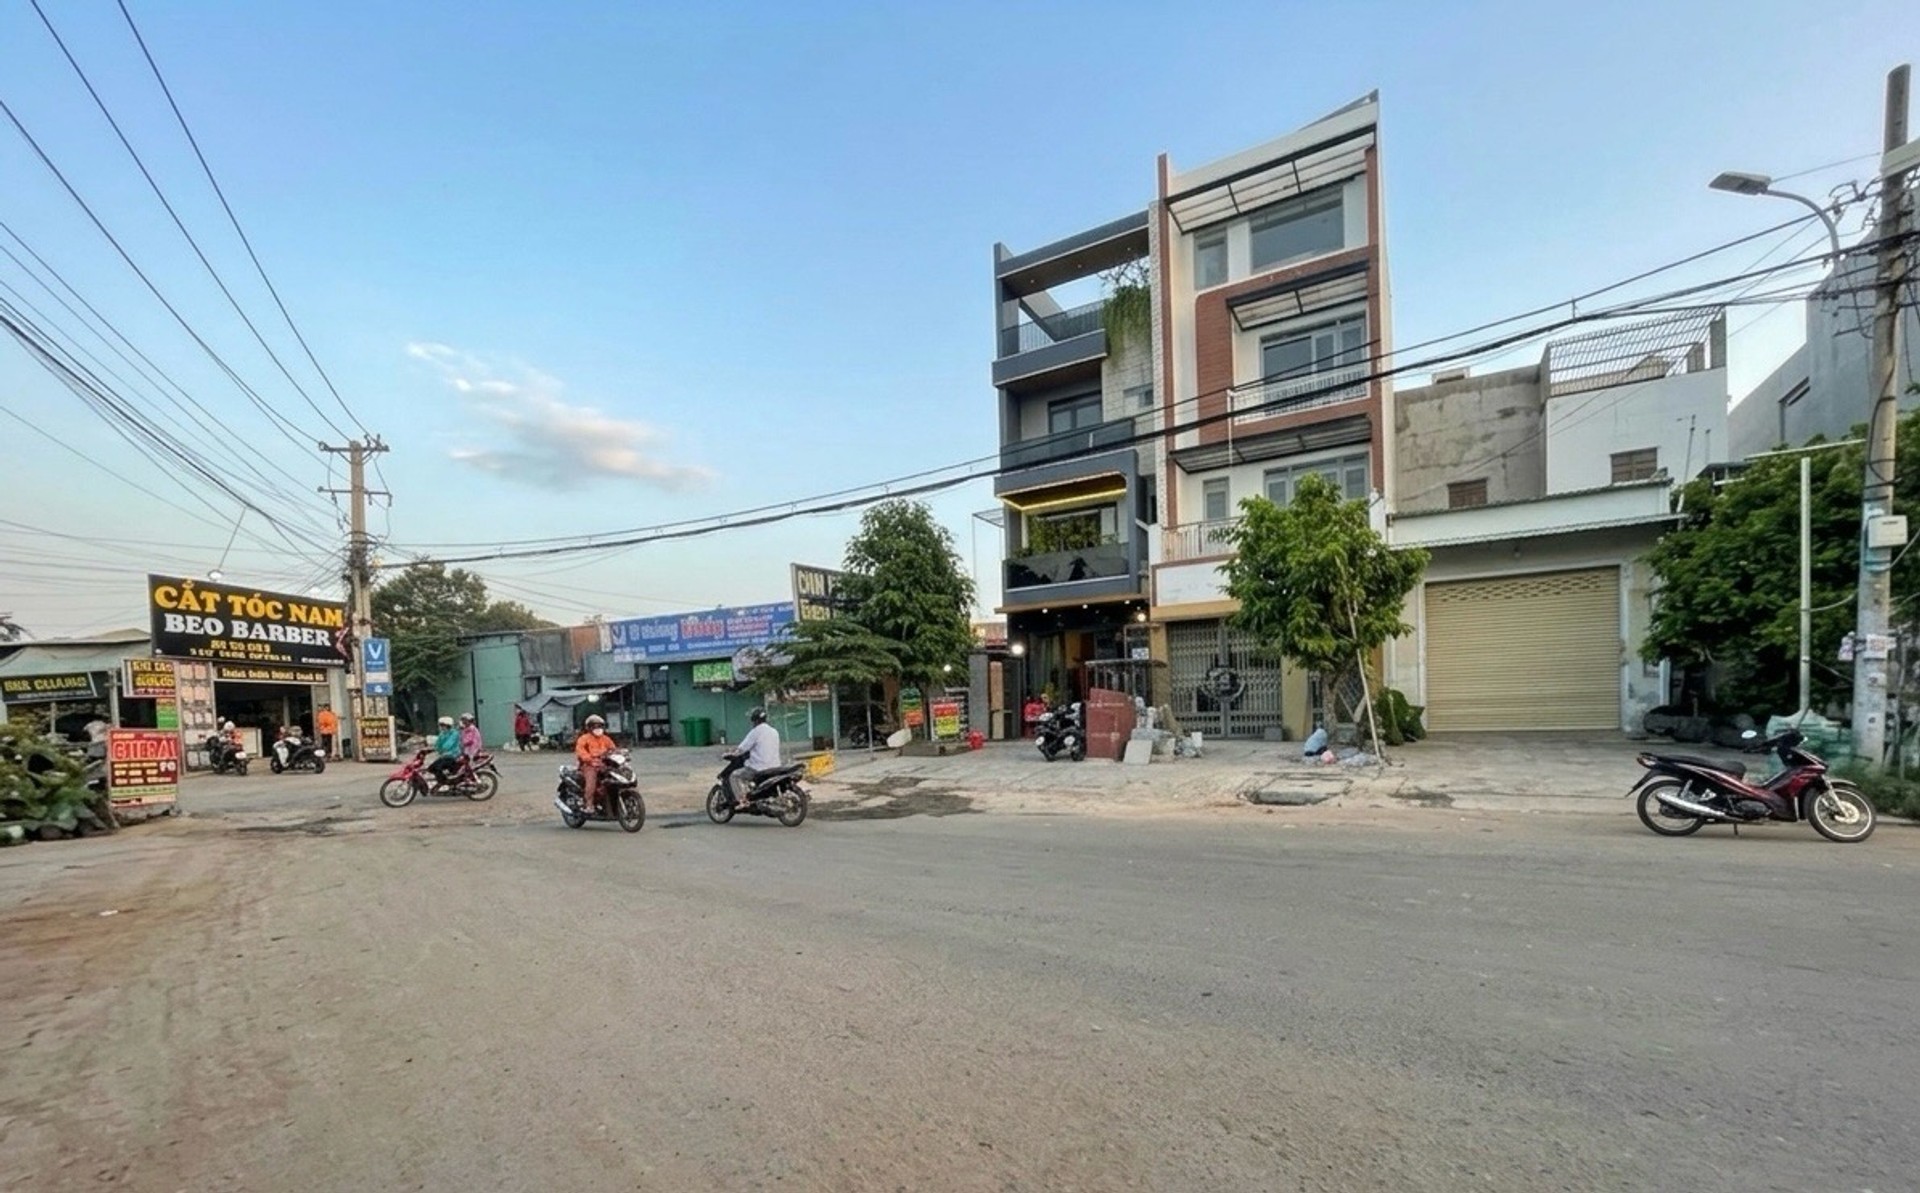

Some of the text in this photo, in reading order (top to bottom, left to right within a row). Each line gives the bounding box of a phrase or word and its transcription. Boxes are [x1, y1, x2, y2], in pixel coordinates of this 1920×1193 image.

[288, 603, 344, 627] NAM
[164, 613, 331, 646] BEO BARBER
